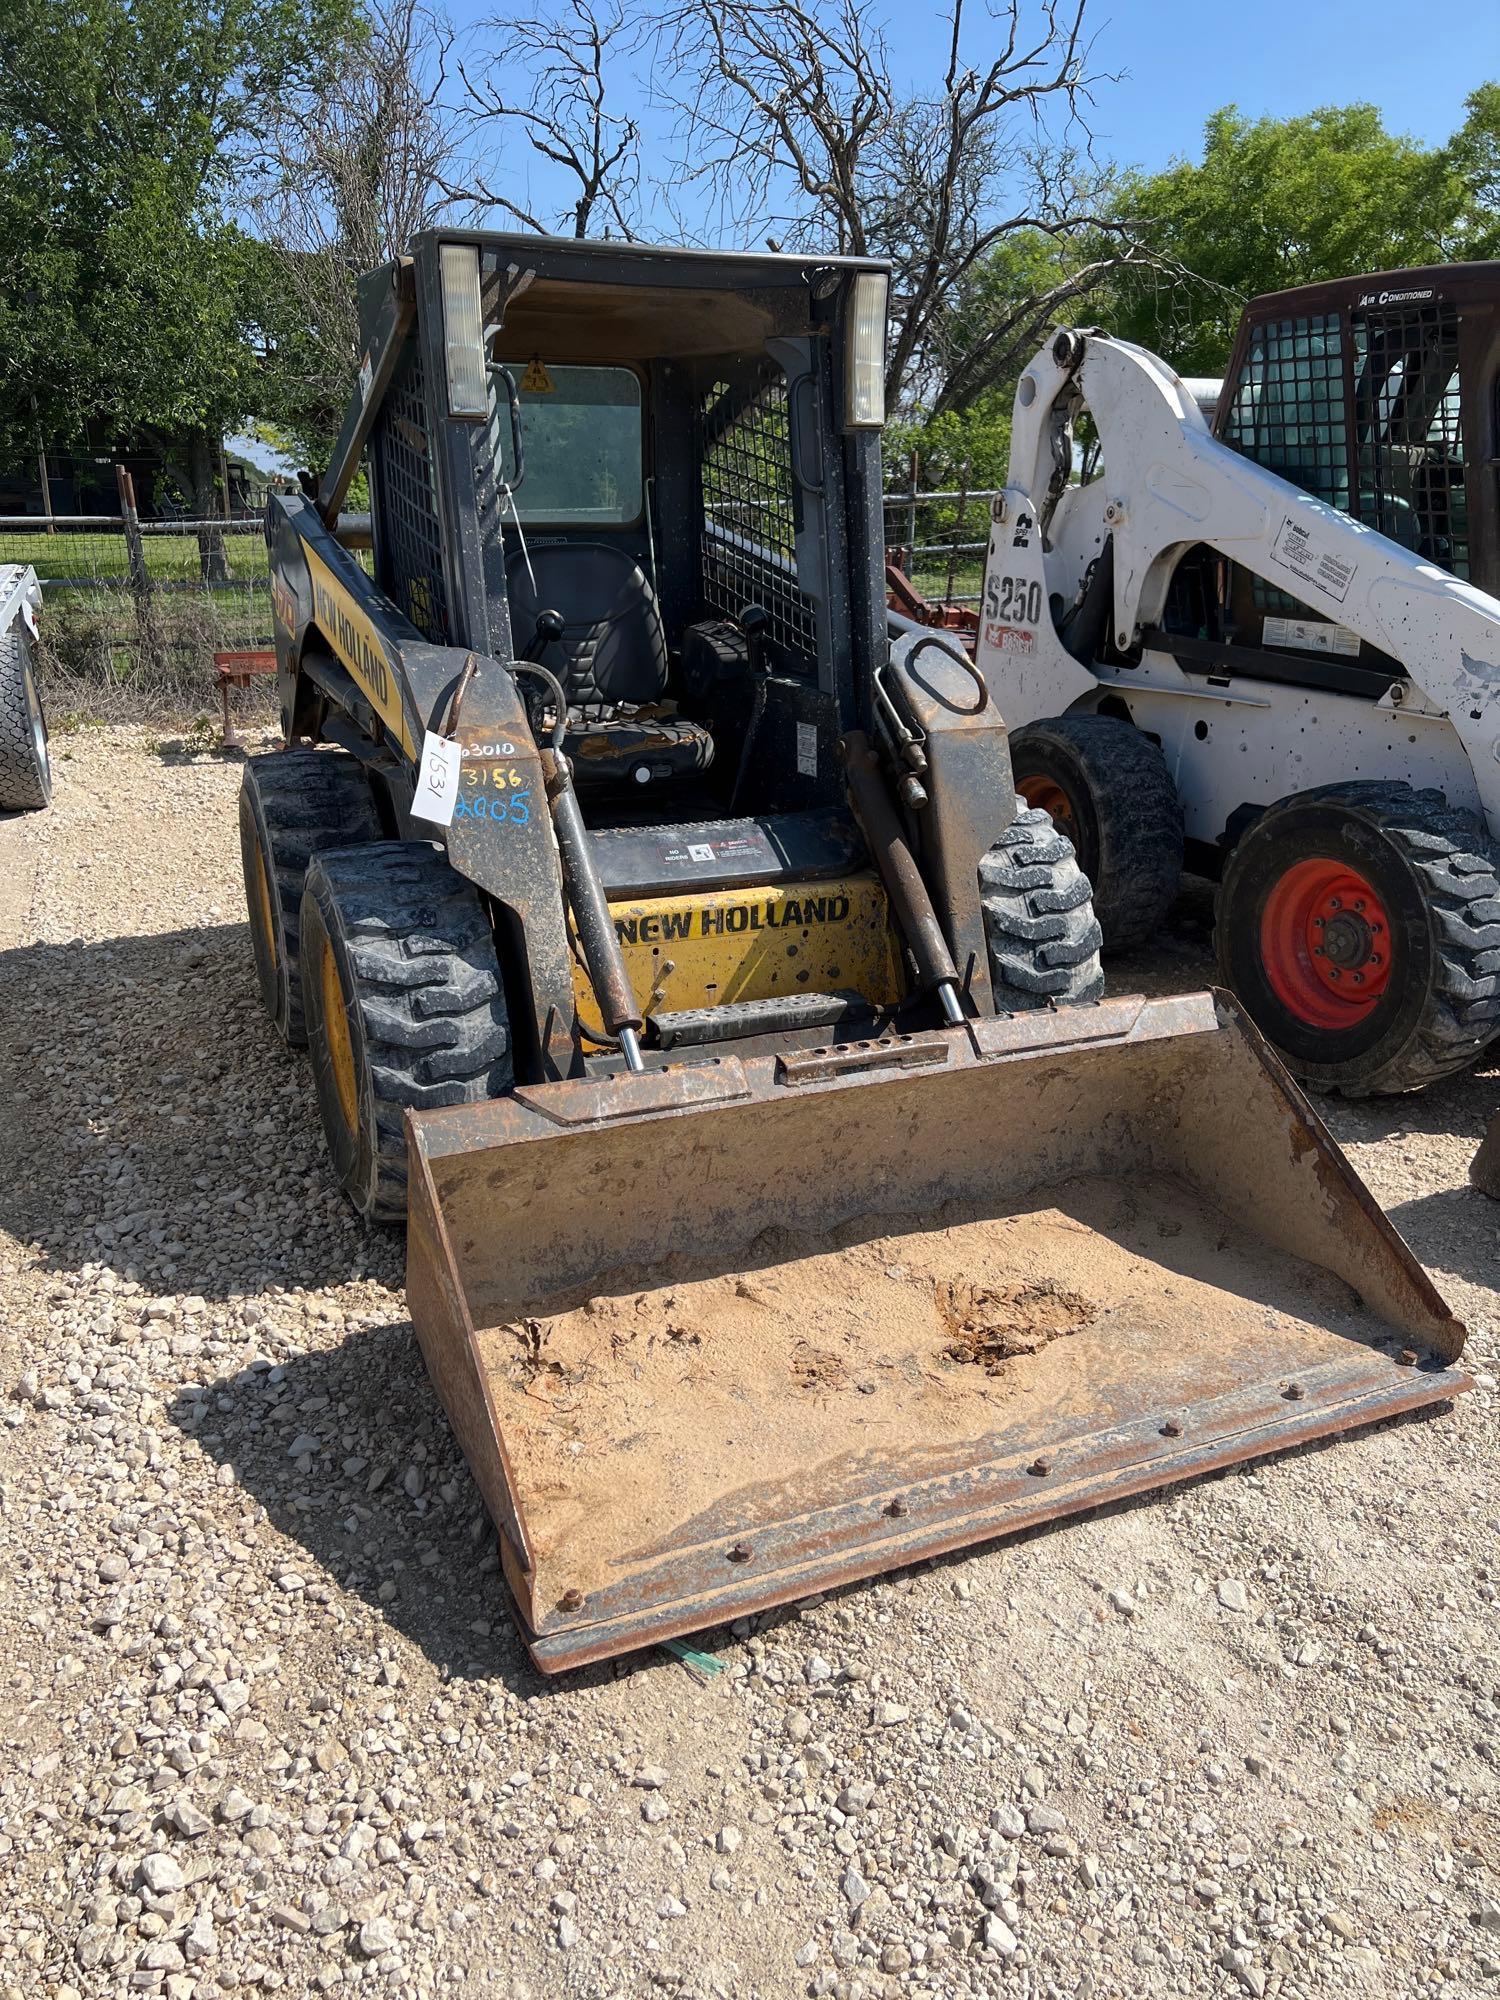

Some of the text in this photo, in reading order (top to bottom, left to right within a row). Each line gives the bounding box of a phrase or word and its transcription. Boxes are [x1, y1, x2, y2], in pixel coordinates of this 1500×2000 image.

[985, 574, 1042, 625] S250
[316, 579, 389, 708] NEW HOLLAND
[427, 751, 450, 799] 1531
[461, 767, 522, 790] 3156
[455, 789, 531, 826] 2005
[614, 894, 850, 946] NEW HOLLAND
